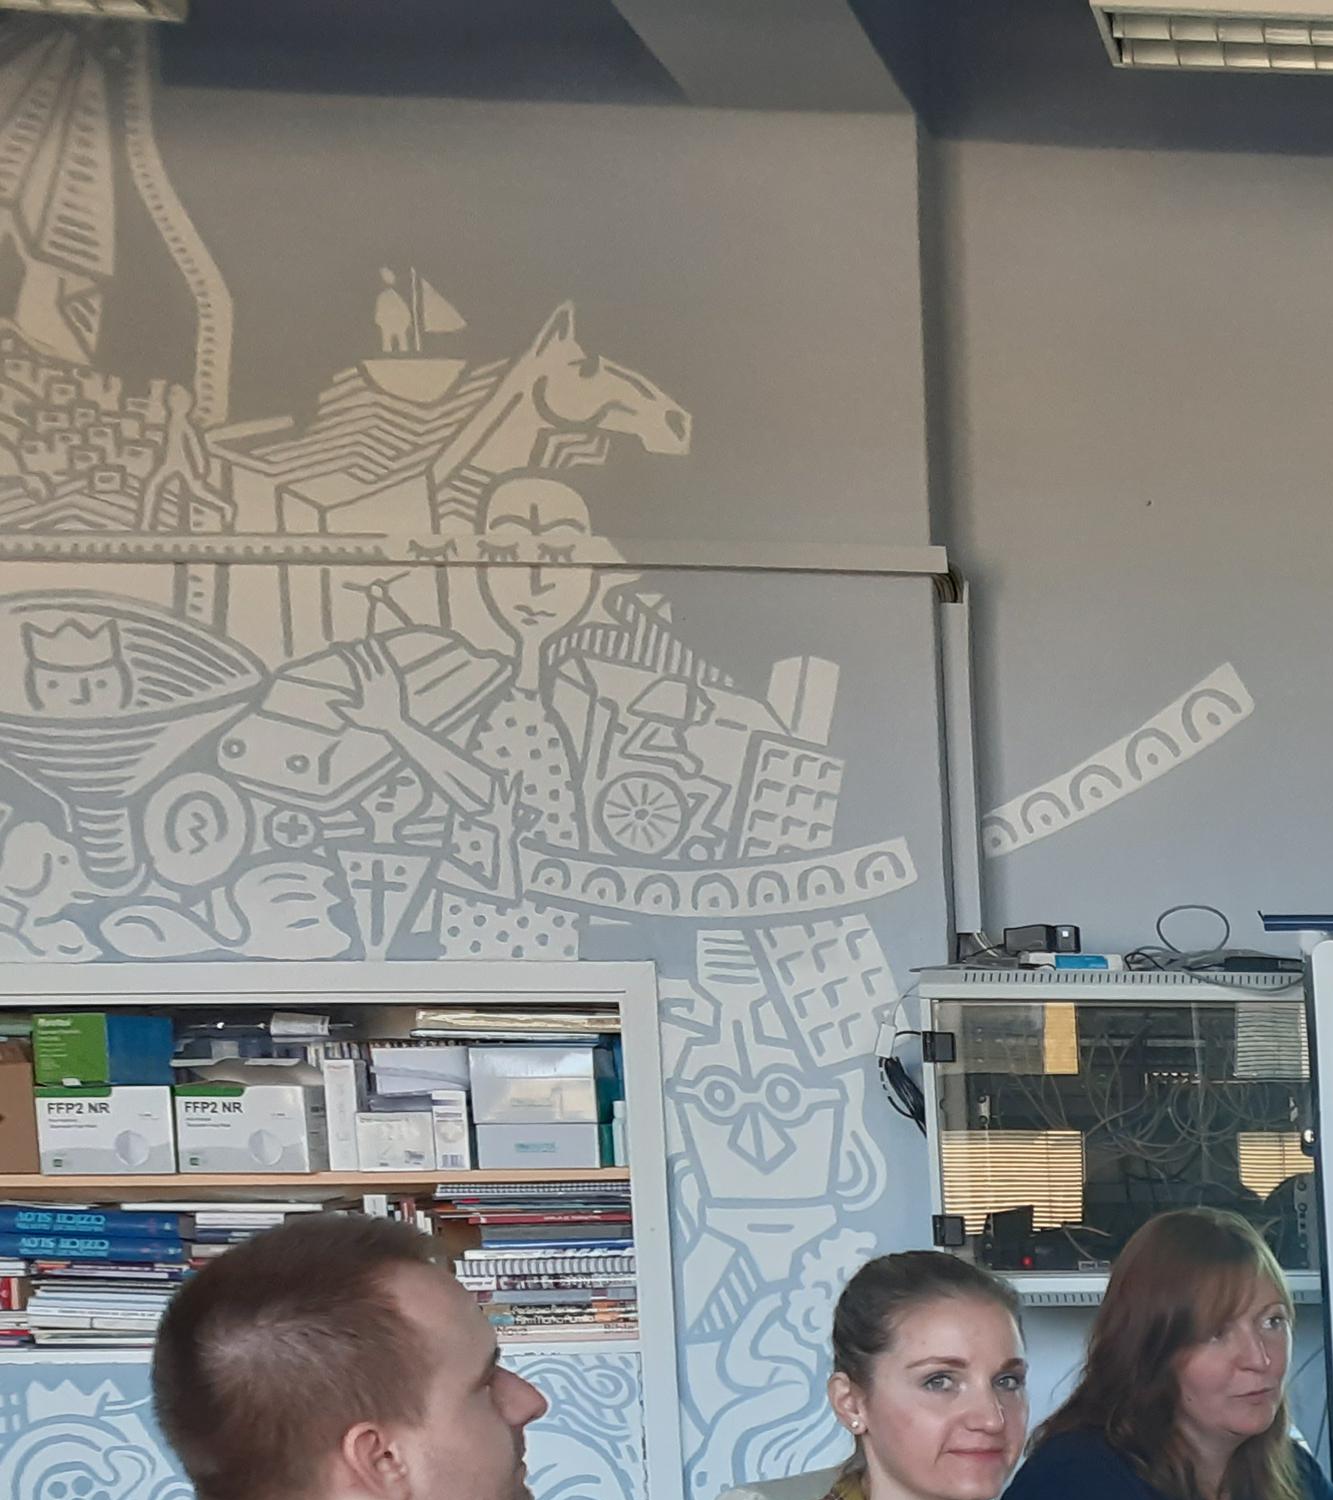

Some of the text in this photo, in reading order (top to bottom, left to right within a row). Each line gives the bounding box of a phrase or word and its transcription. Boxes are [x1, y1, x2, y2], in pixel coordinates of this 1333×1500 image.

[47, 1102, 111, 1115] FFP2 NR
[184, 1101, 244, 1114] FFP2 NR
